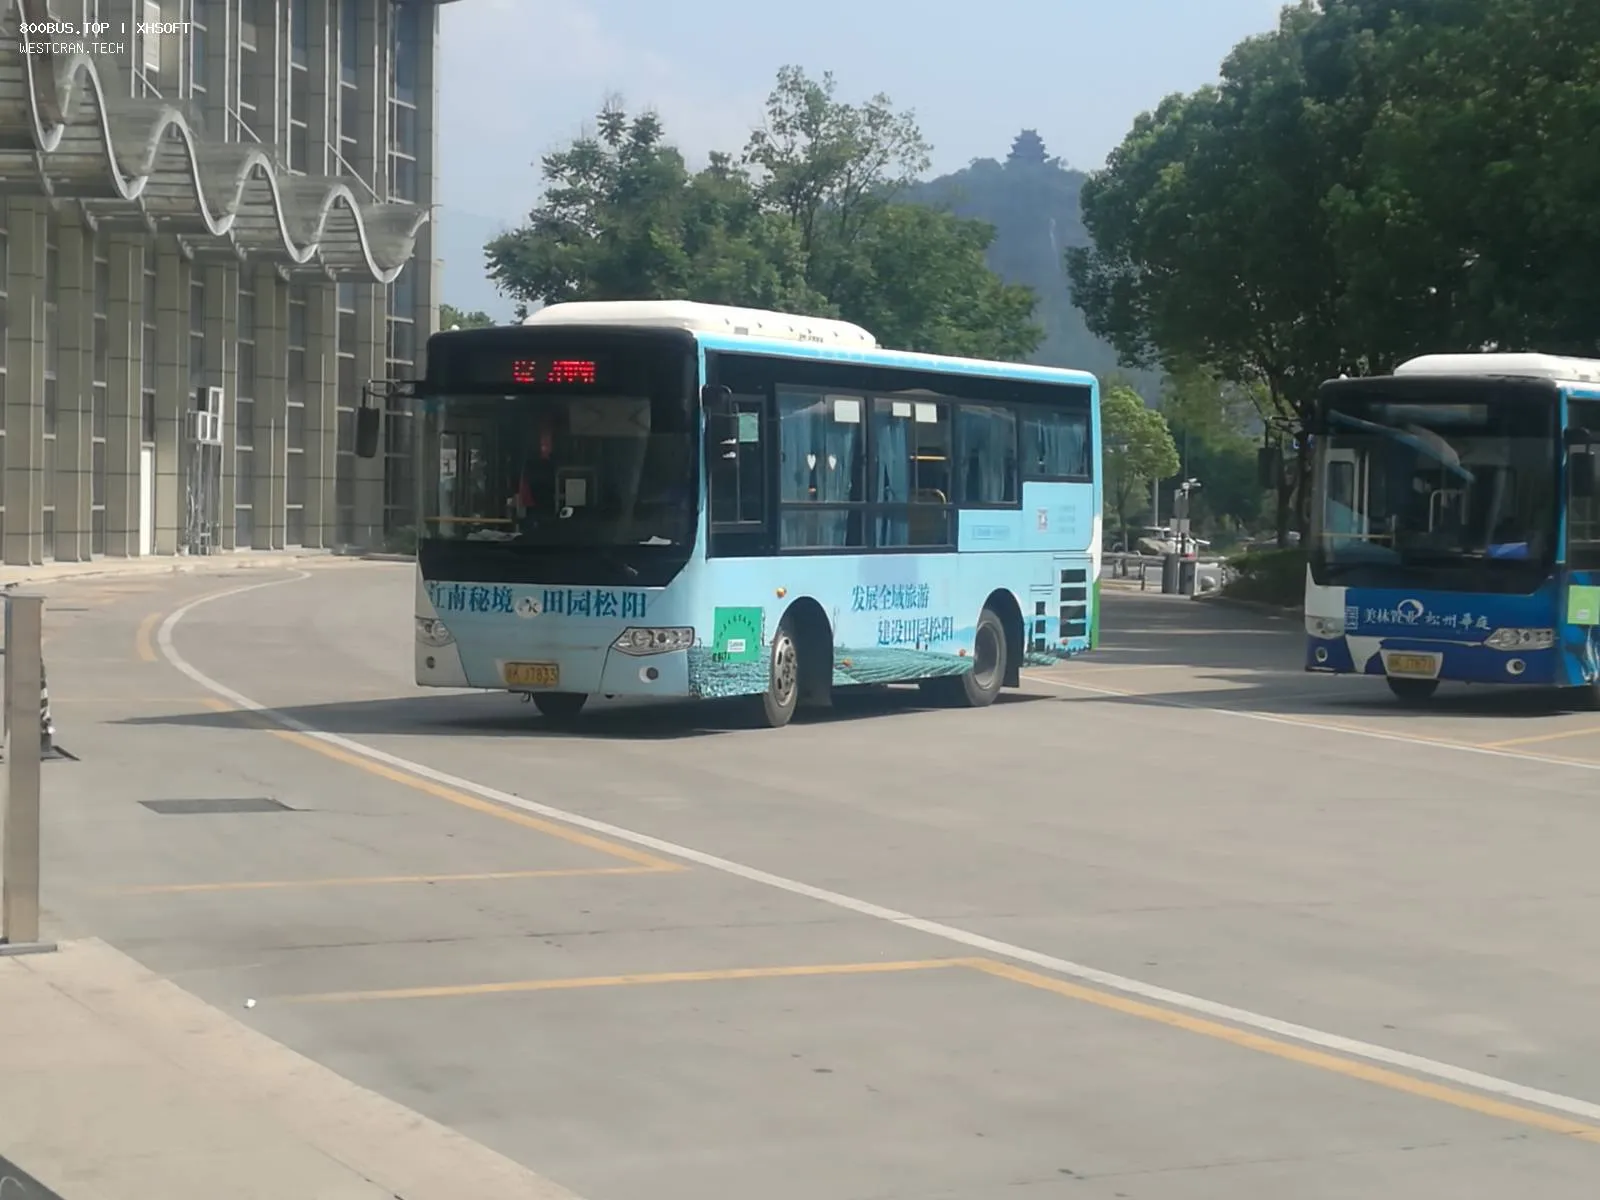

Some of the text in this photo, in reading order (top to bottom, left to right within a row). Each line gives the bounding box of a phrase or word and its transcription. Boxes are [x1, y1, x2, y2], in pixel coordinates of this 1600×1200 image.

[427, 582, 647, 618] 江南秘境 田园松阳
[851, 583, 930, 611] 发展全域旅游
[878, 615, 954, 644] 建设田园松阳
